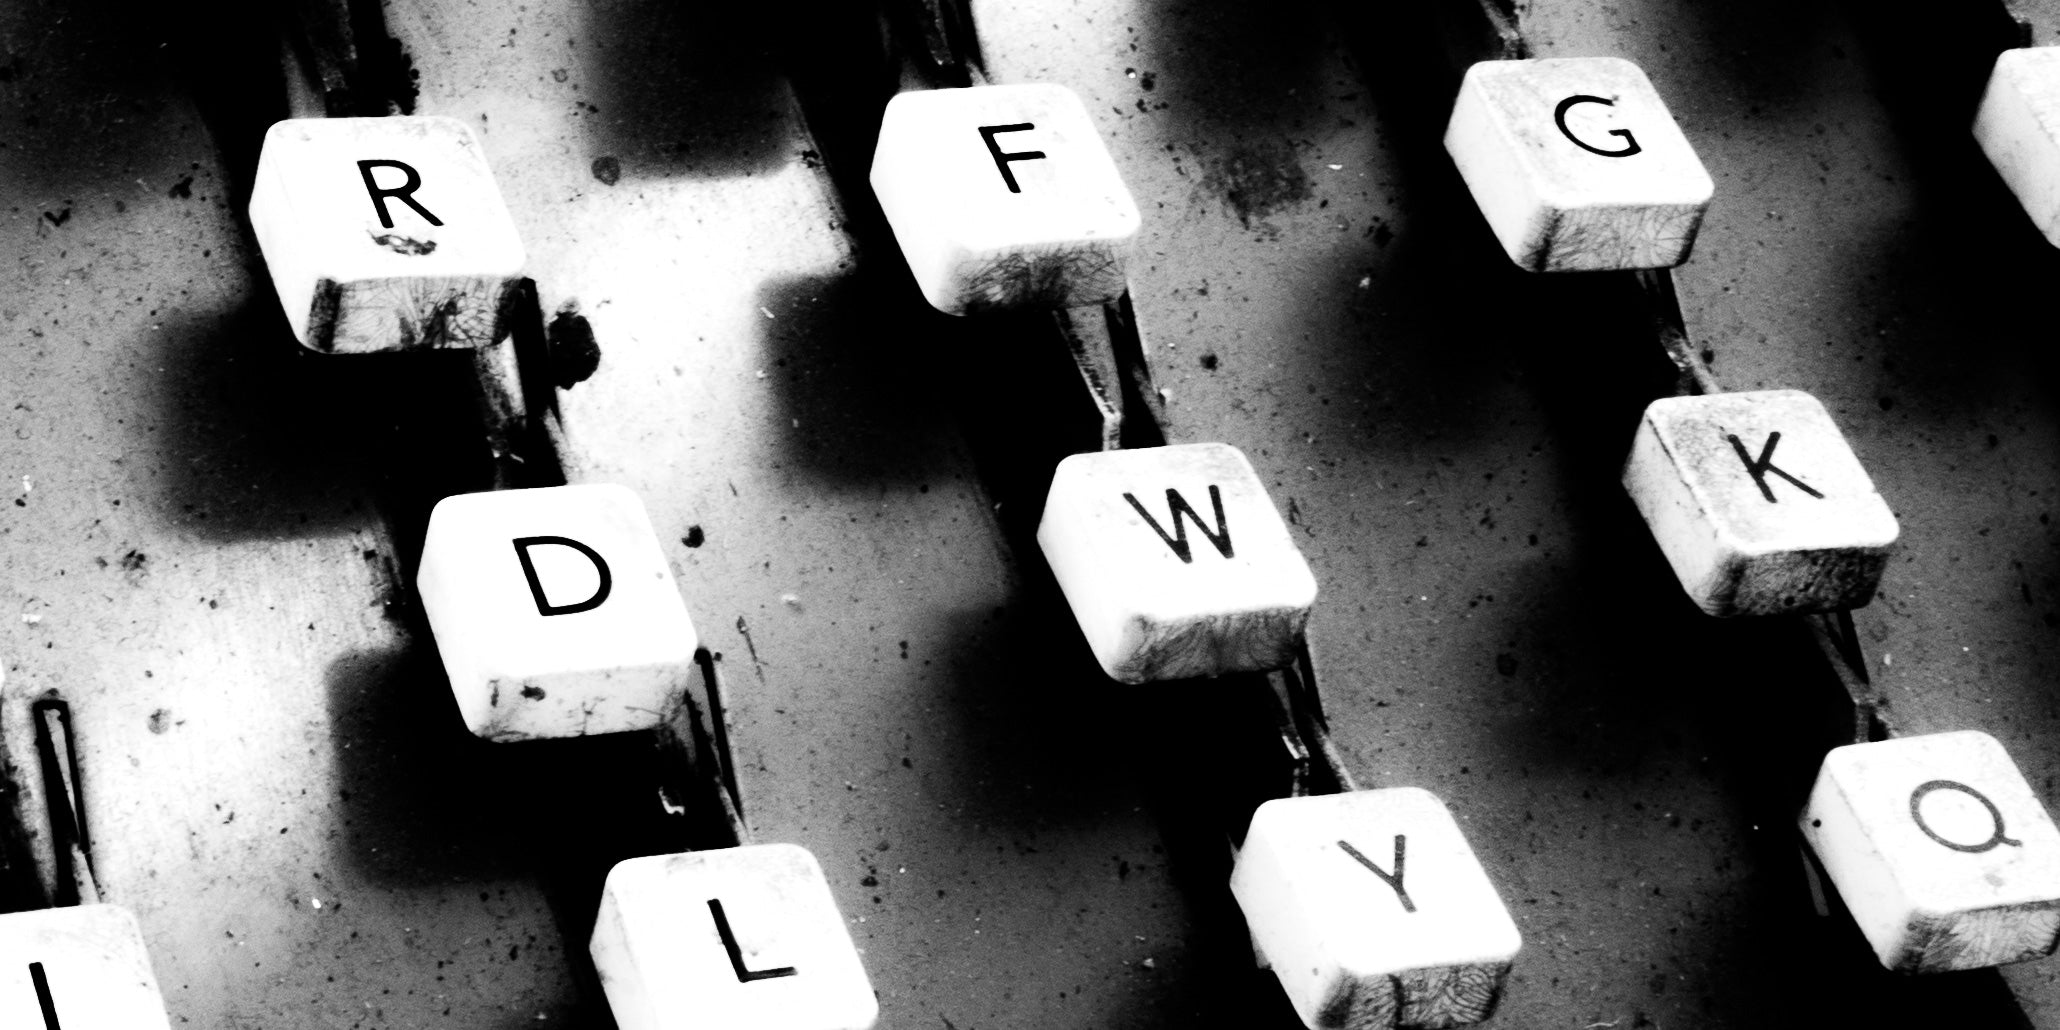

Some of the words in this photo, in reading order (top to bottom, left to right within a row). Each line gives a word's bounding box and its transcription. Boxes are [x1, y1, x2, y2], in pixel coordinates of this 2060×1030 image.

[978, 122, 1046, 194] F
[1553, 94, 1642, 158] G
[357, 159, 445, 229] R
[1726, 431, 1824, 504] K
[1122, 484, 1234, 564] W
[512, 535, 613, 617] D
[1910, 780, 2023, 853] Q
[1338, 834, 1417, 913] Y
[706, 898, 797, 984] L
